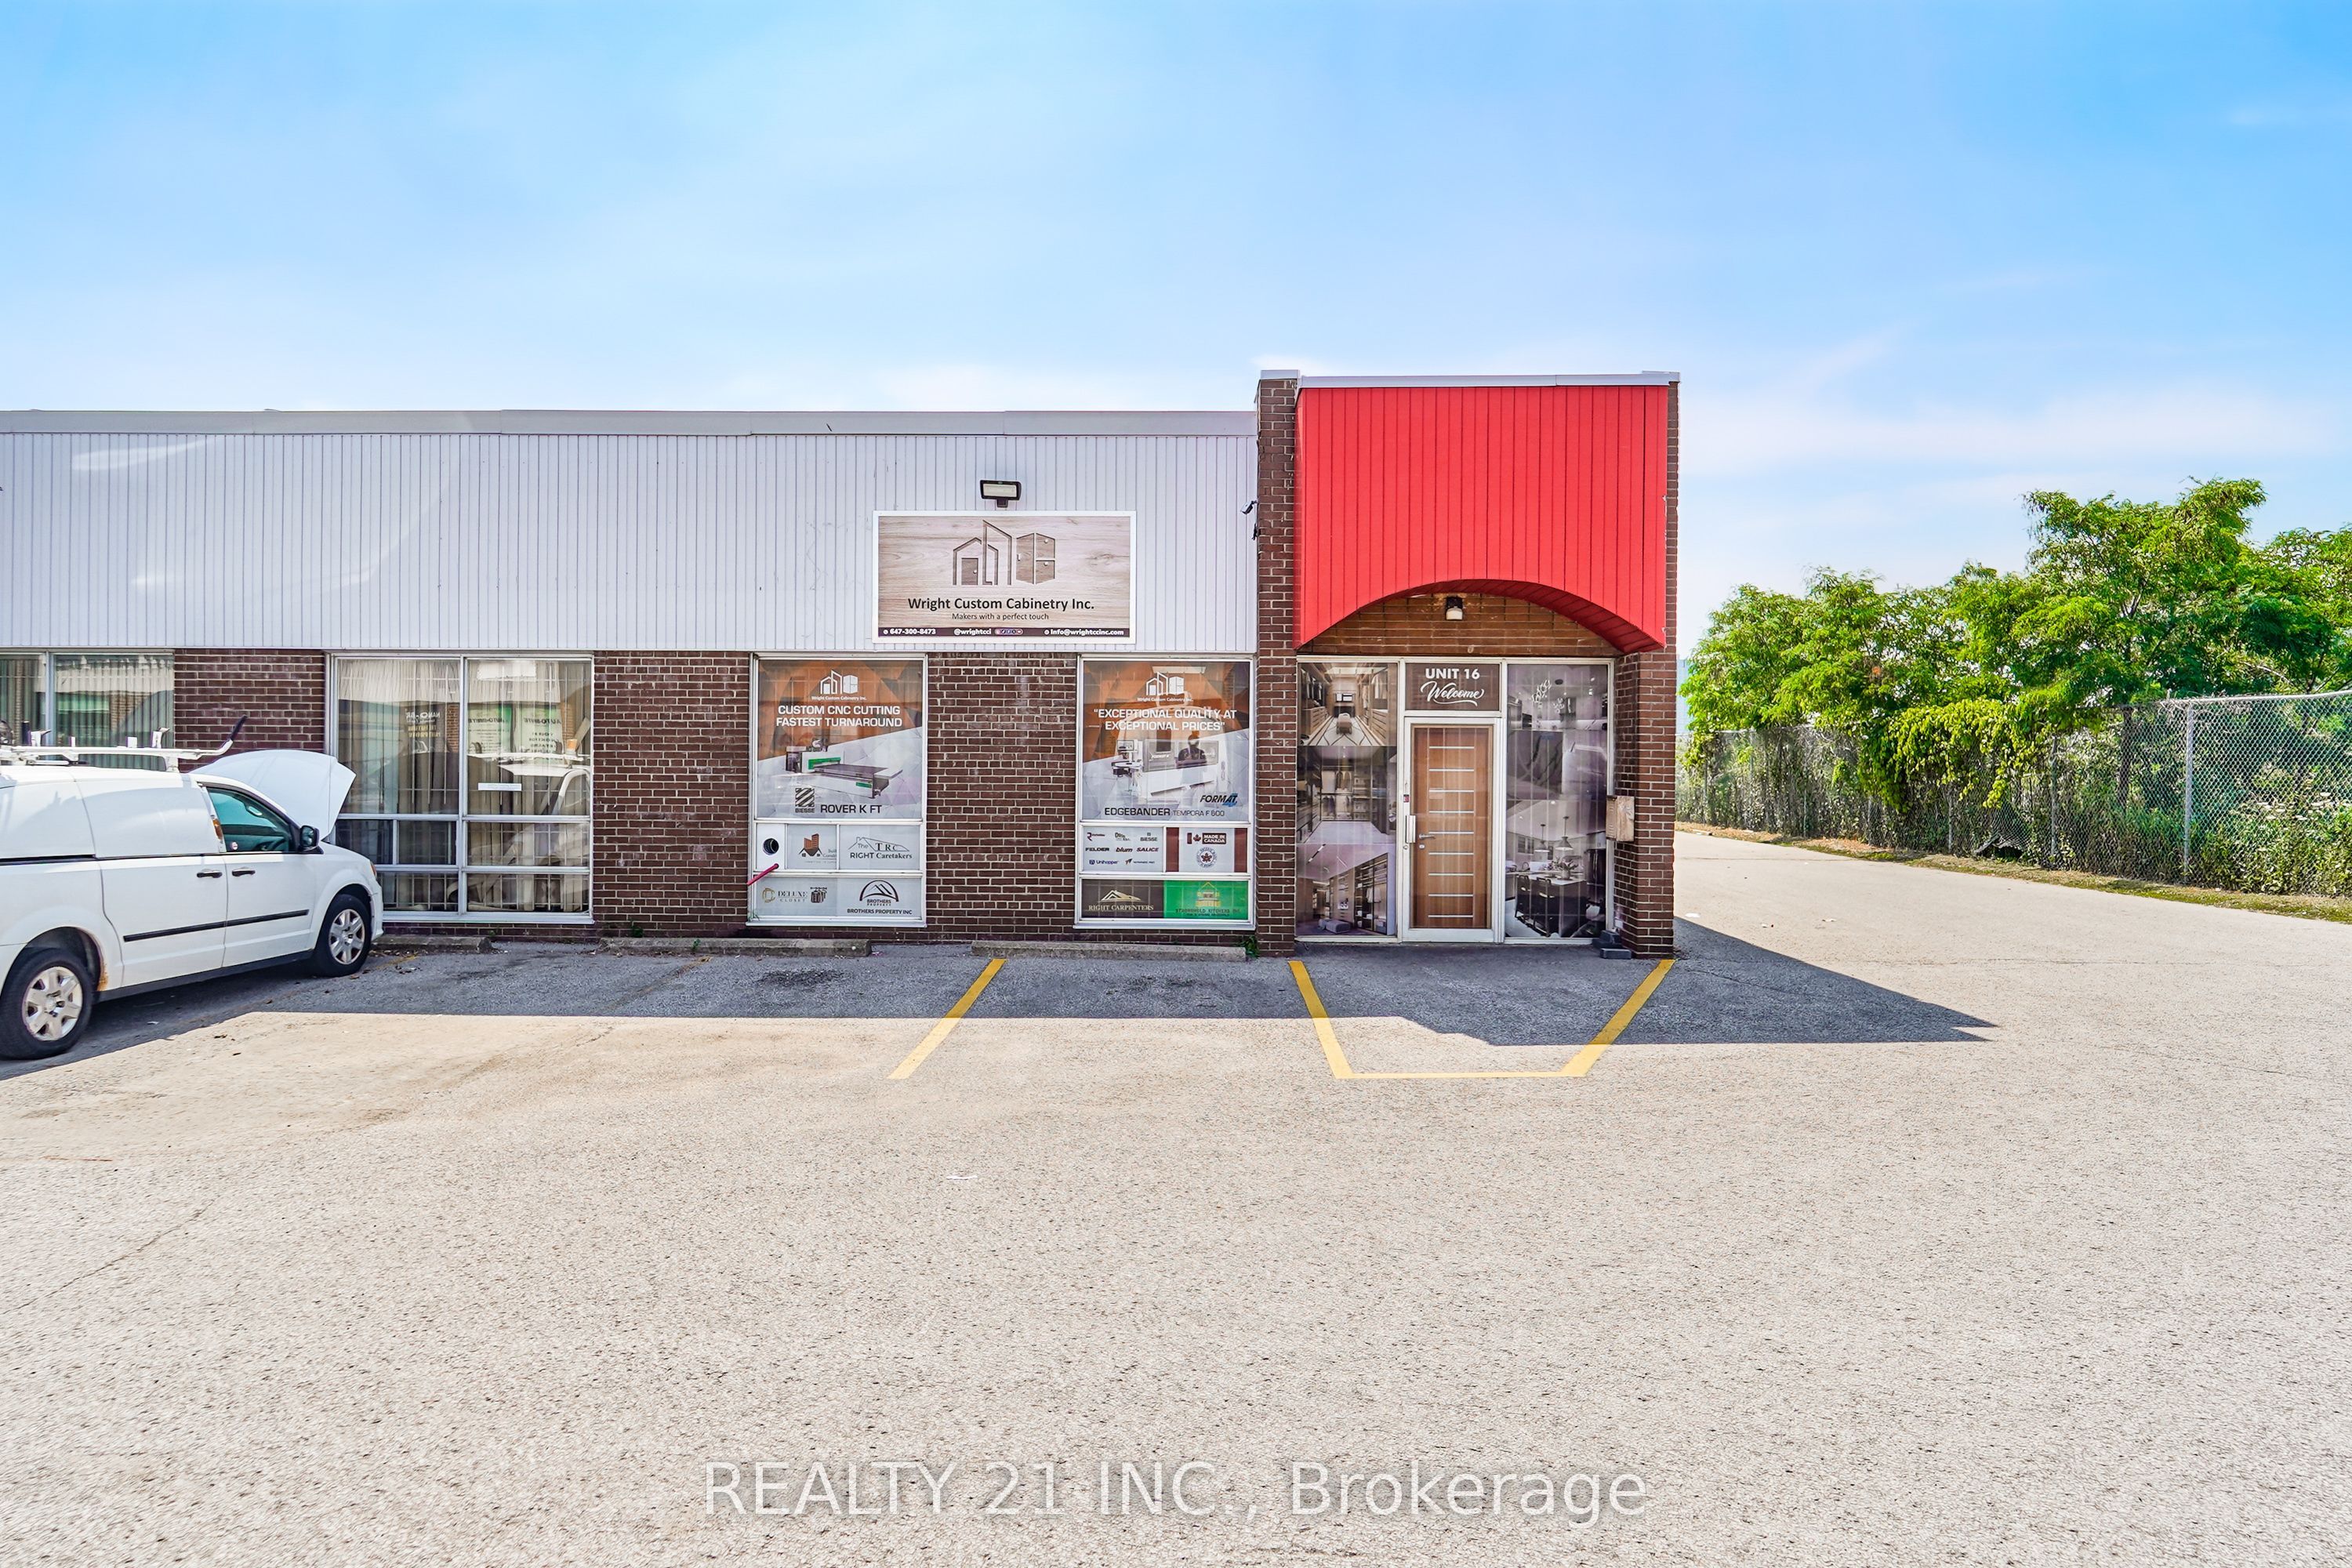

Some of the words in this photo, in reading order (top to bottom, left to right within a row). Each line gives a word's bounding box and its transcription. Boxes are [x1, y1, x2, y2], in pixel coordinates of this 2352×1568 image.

[908, 597, 950, 612] Wright
[954, 597, 1002, 609] Custom
[1006, 597, 1068, 612] Cabinetry
[1072, 598, 1094, 609] Inc.
[1003, 612, 1028, 622] perfect
[1425, 668, 1460, 679] UNIT
[1464, 668, 1480, 680] 16
[1421, 681, 1485, 706] Welcome
[778, 705, 825, 715] CUSTOM
[827, 705, 851, 715] CNC
[853, 705, 901, 715] CUTTING
[1174, 709, 1221, 719] QUALITY
[1222, 710, 1237, 719] AT
[776, 717, 822, 727] FASTEST
[825, 717, 902, 728] TURNAROUND
[1105, 720, 1179, 731] EXCEPTIONAL
[820, 804, 856, 814] ROVER
[859, 804, 867, 814] K
[869, 804, 883, 814] FT
[1105, 807, 1171, 816] EDGEBANDER
